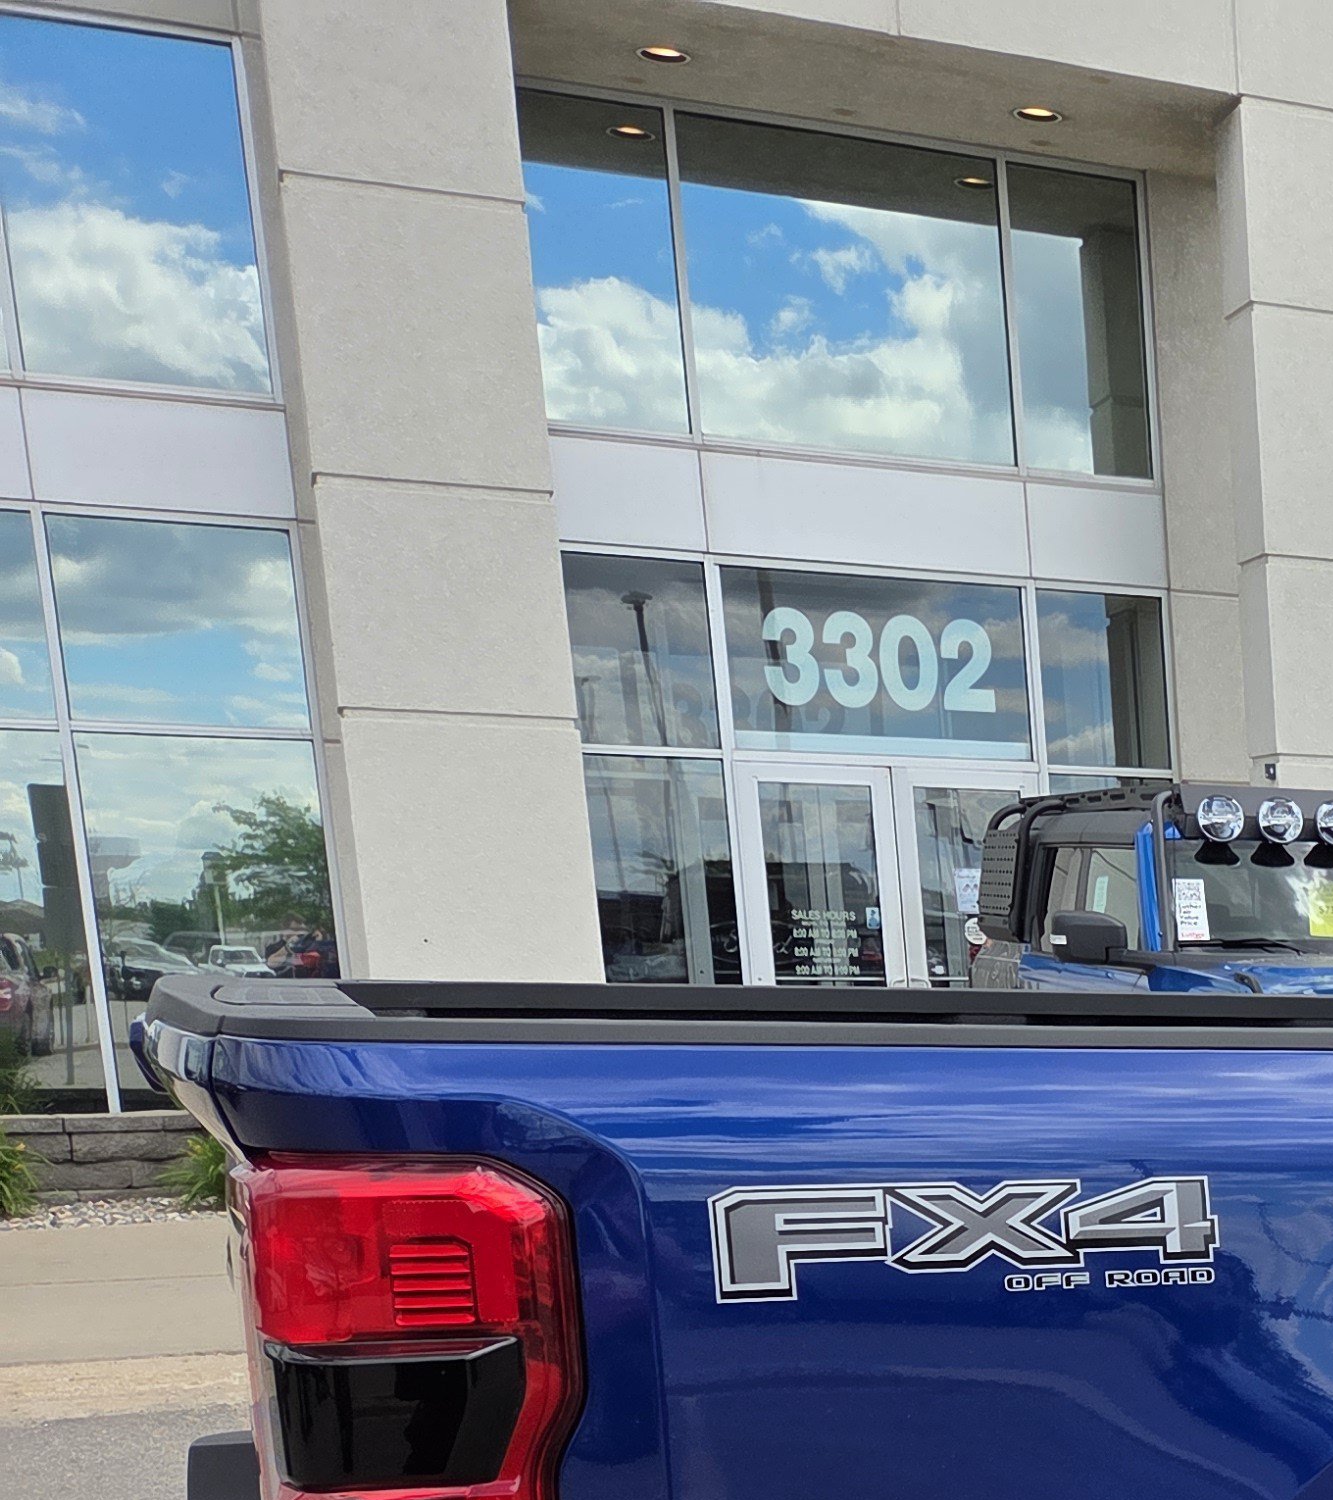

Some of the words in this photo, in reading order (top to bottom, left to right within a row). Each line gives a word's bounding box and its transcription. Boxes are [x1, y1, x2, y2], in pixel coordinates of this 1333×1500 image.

[762, 607, 997, 713] 3302
[791, 908, 821, 920] SALES
[823, 910, 857, 922] HOURS
[708, 1176, 1220, 1304] FX4
[1004, 1271, 1090, 1292] OFF
[1105, 1267, 1215, 1288] ROAD
